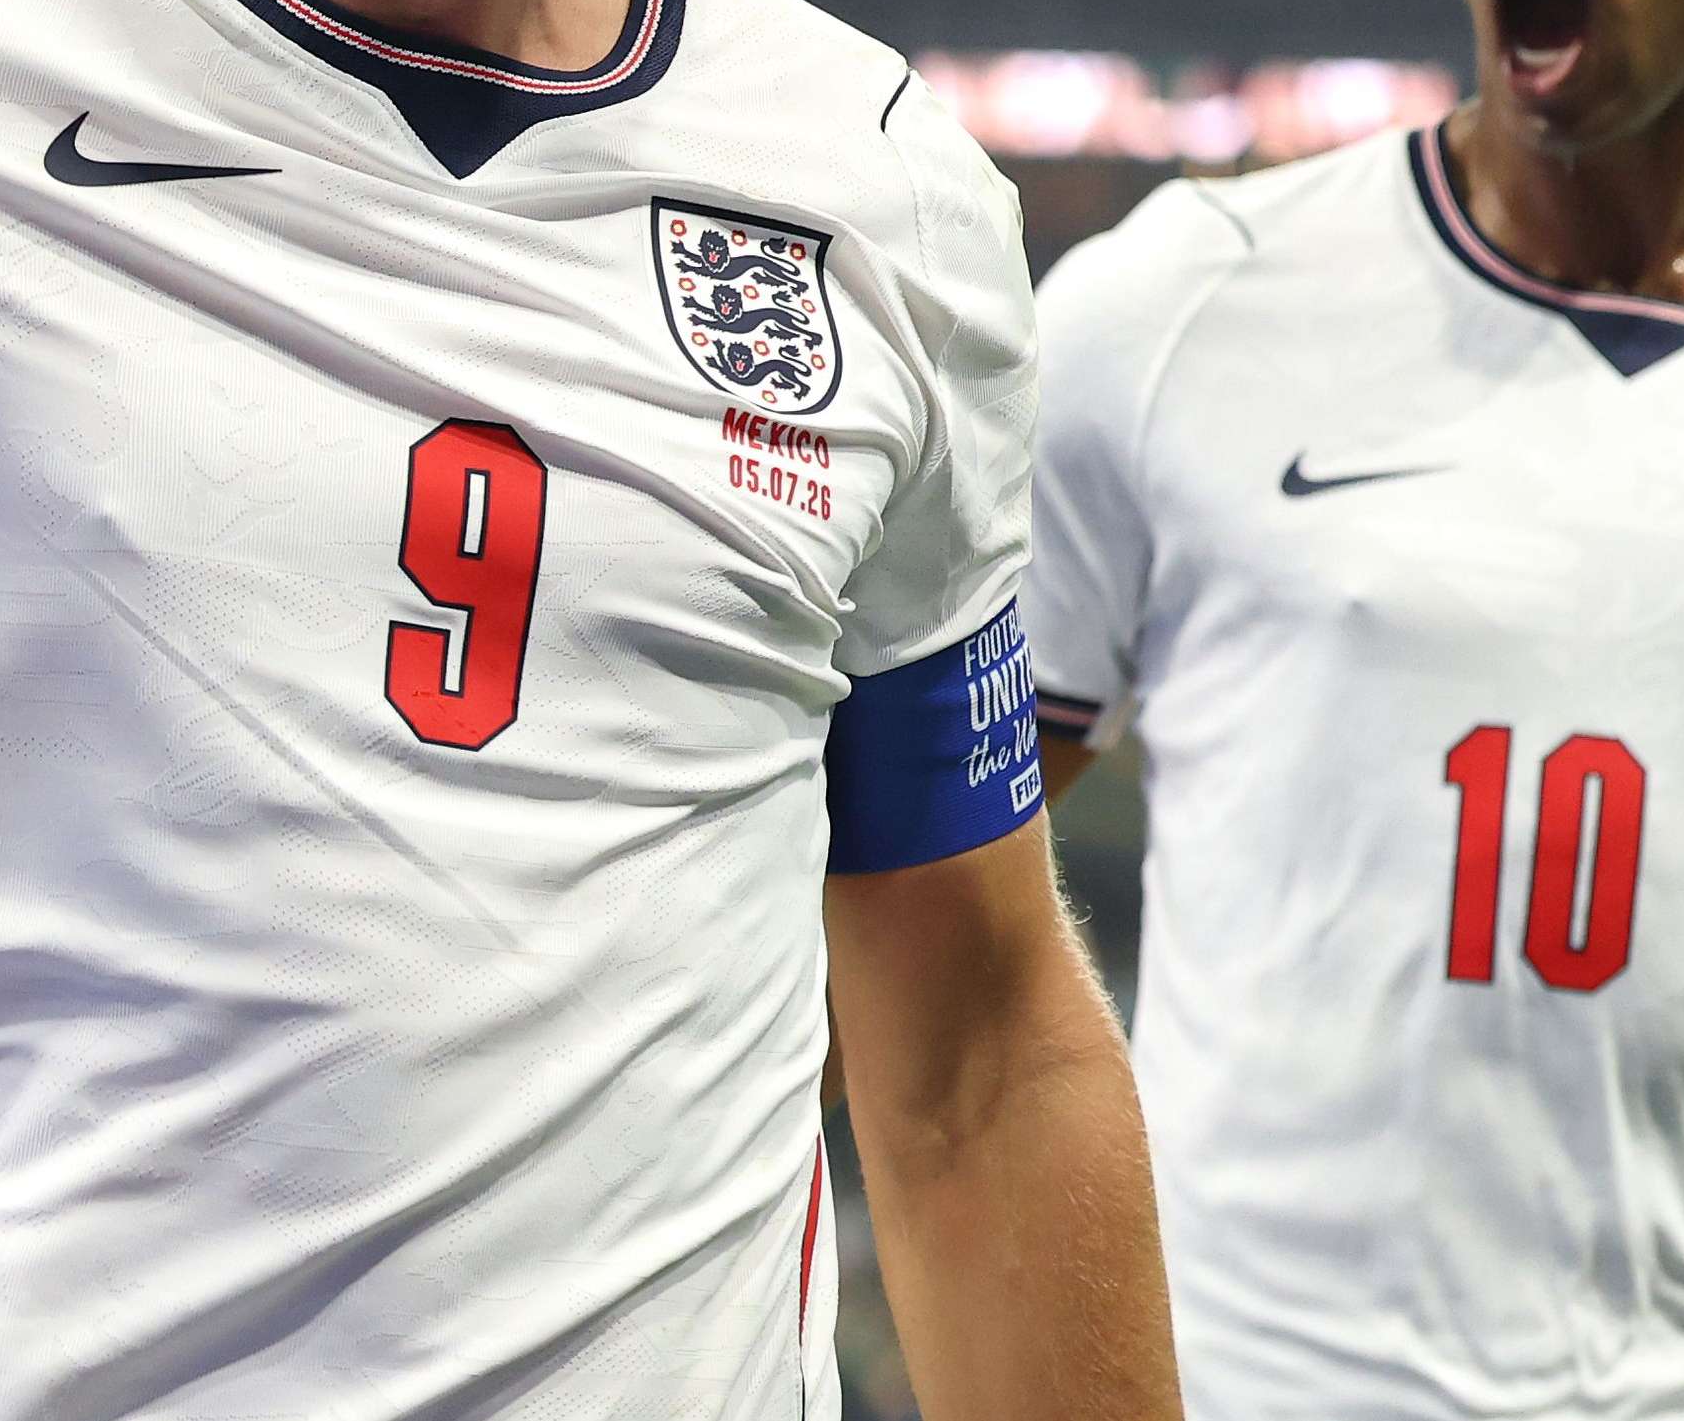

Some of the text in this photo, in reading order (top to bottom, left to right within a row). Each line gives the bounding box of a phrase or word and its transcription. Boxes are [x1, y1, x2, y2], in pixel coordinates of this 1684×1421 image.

[722, 407, 830, 469] MEXICO
[729, 455, 830, 520] 05.07.26
[385, 417, 548, 751] 9
[960, 735, 1011, 788] the
[1445, 724, 1646, 992] 10
